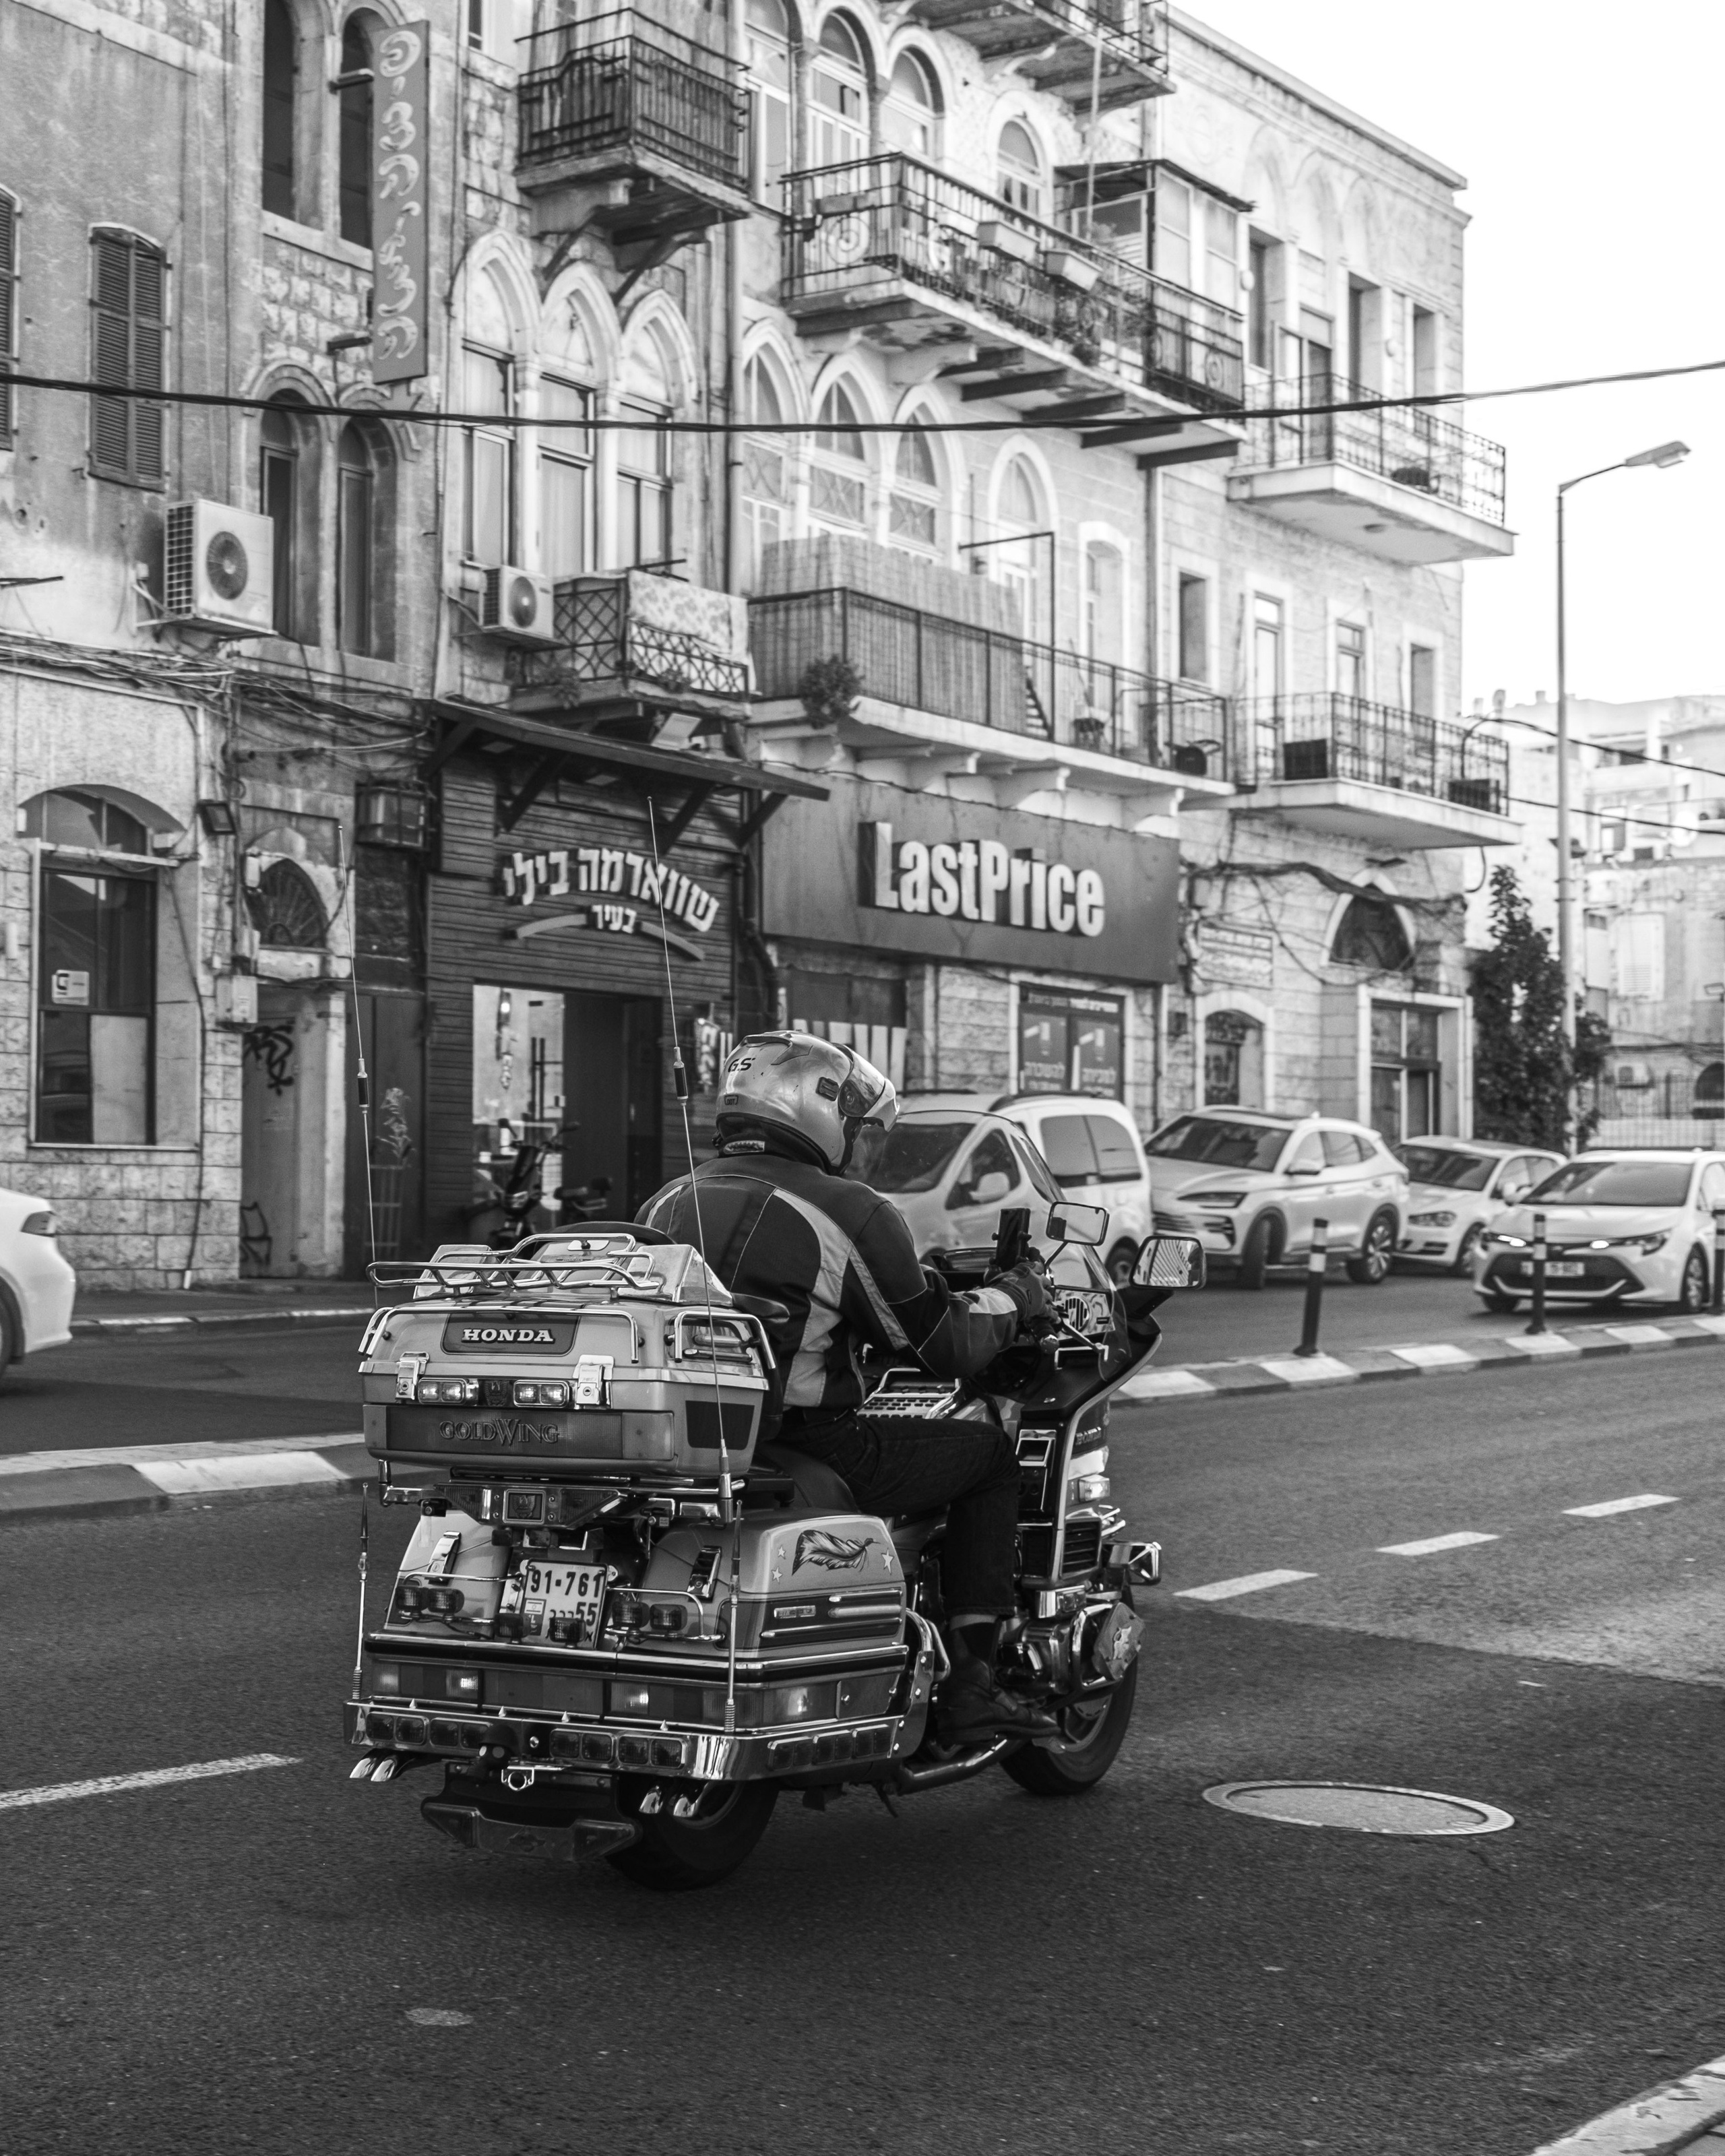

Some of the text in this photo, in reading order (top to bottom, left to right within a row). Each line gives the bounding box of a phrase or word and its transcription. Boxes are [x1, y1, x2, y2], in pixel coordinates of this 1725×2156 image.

[577, 848, 720, 932] שווארמה
[874, 821, 1105, 937] LastPrice
[461, 1328, 555, 1343] HONDA
[530, 1569, 602, 1598] 91-761
[575, 1601, 598, 1626] 55
